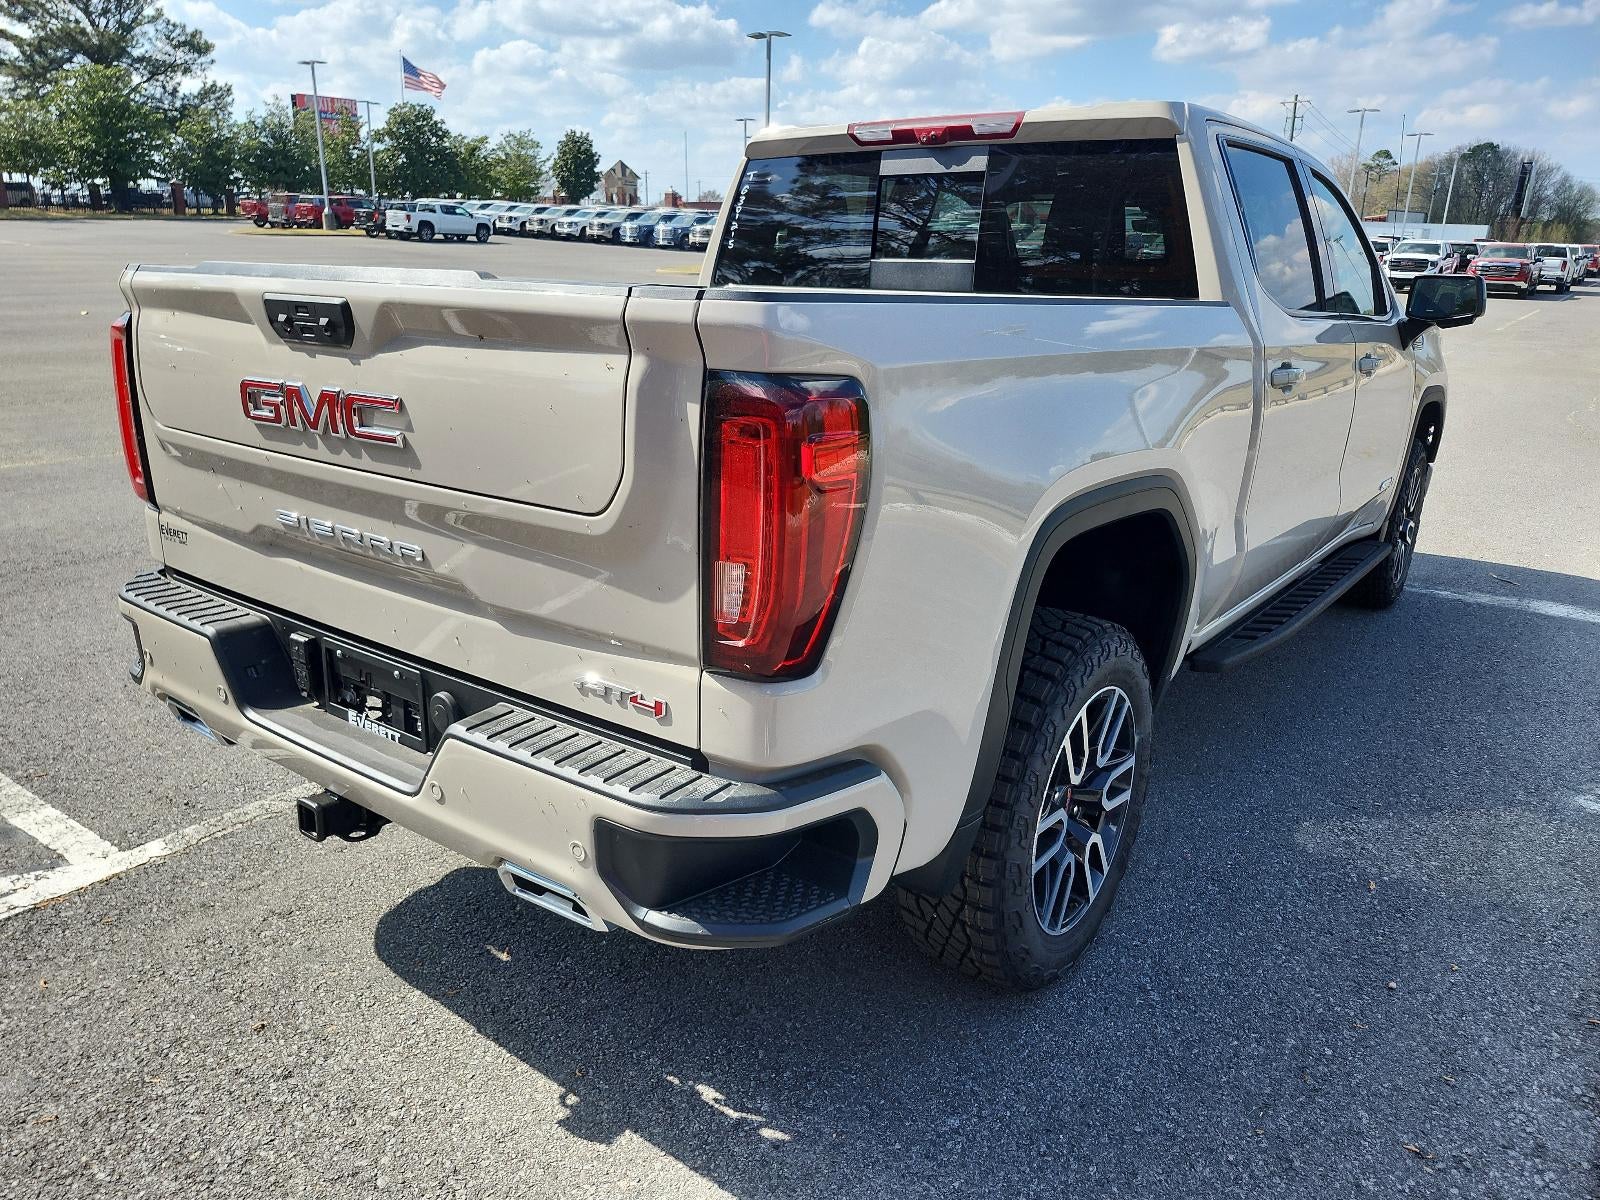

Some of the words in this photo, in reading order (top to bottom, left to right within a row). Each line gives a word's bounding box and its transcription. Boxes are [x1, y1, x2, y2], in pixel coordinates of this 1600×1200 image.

[240, 376, 407, 448] GMC
[160, 521, 188, 543] EVERETT
[275, 509, 425, 562] SIERRA
[574, 677, 667, 719] AT4
[348, 708, 401, 744] EVERETT
